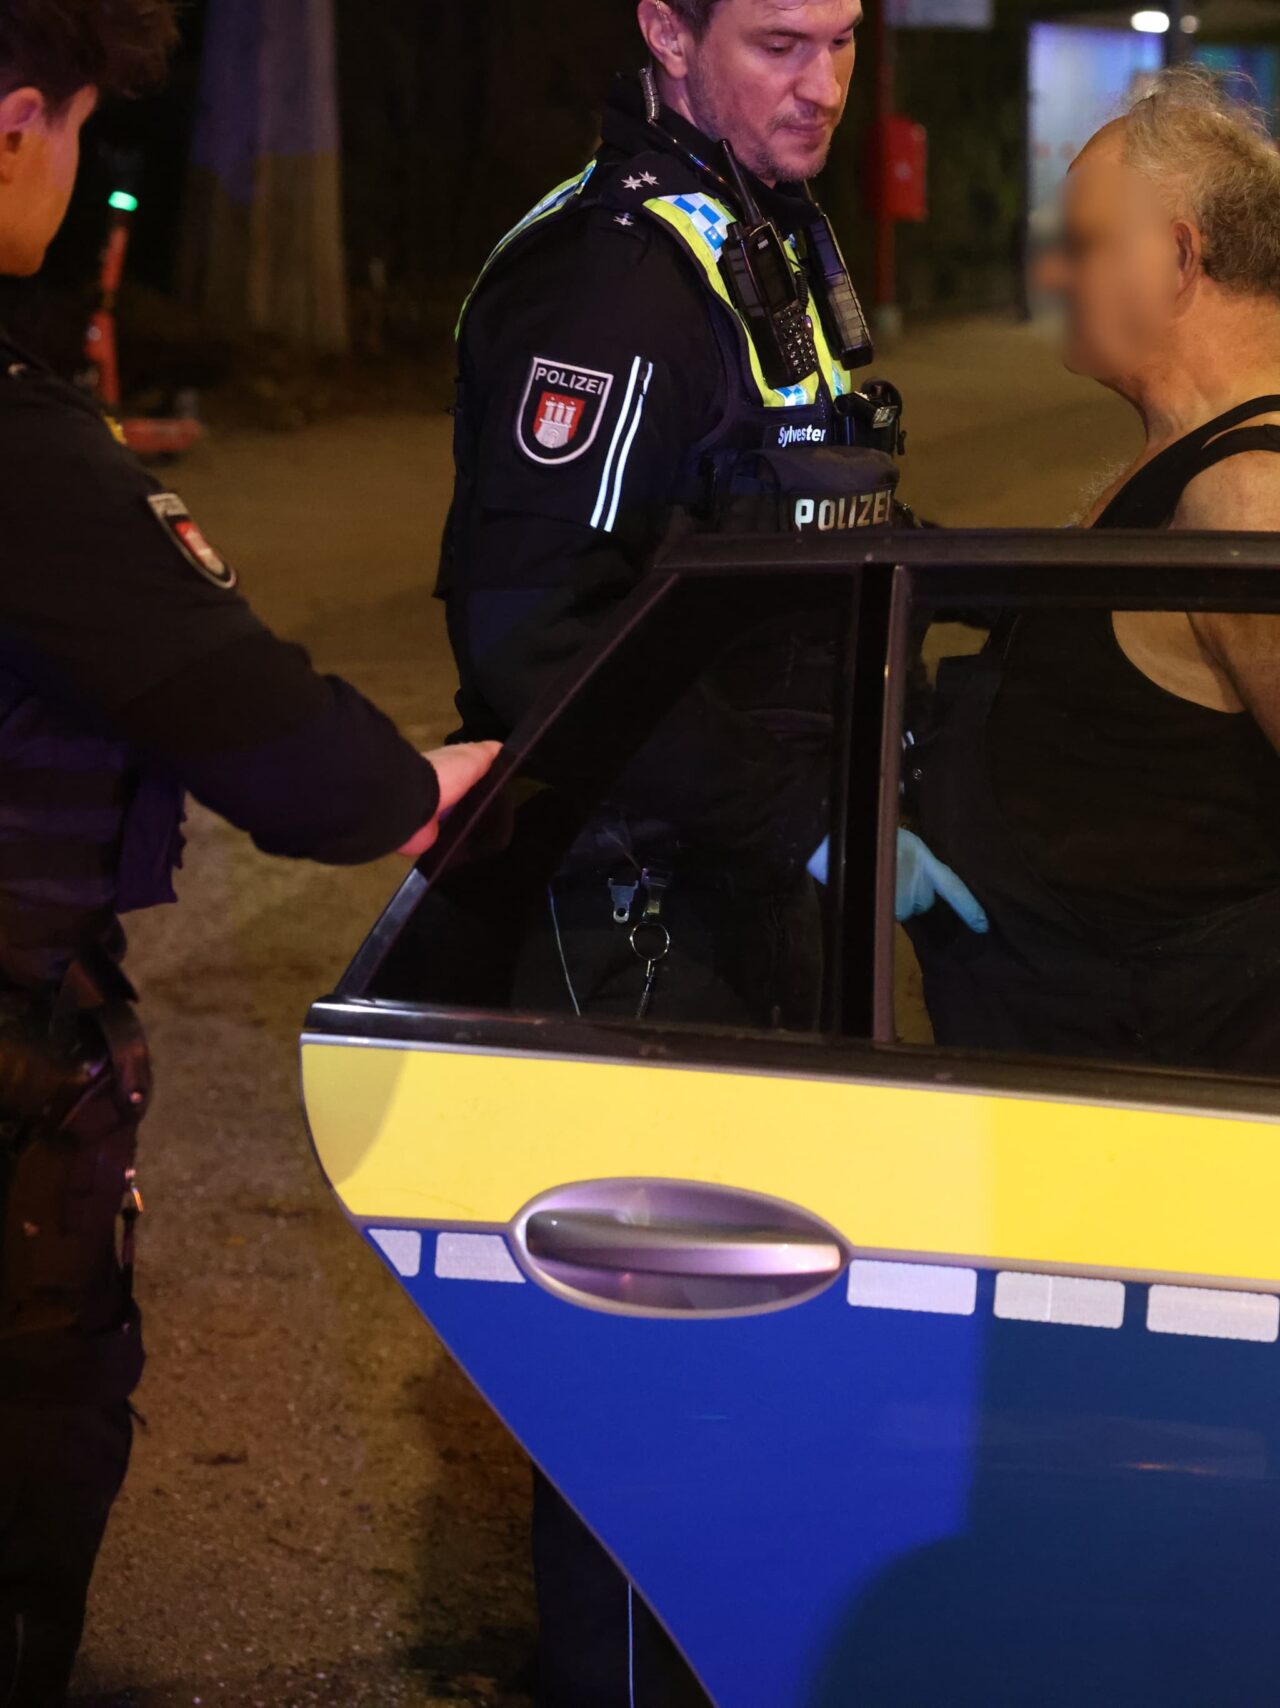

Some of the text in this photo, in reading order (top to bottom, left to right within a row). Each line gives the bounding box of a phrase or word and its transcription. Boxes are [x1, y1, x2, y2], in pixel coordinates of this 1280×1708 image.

[535, 367, 604, 395] POLIZEI
[778, 424, 826, 448] Sylvester
[795, 489, 891, 532] POLIZEI
